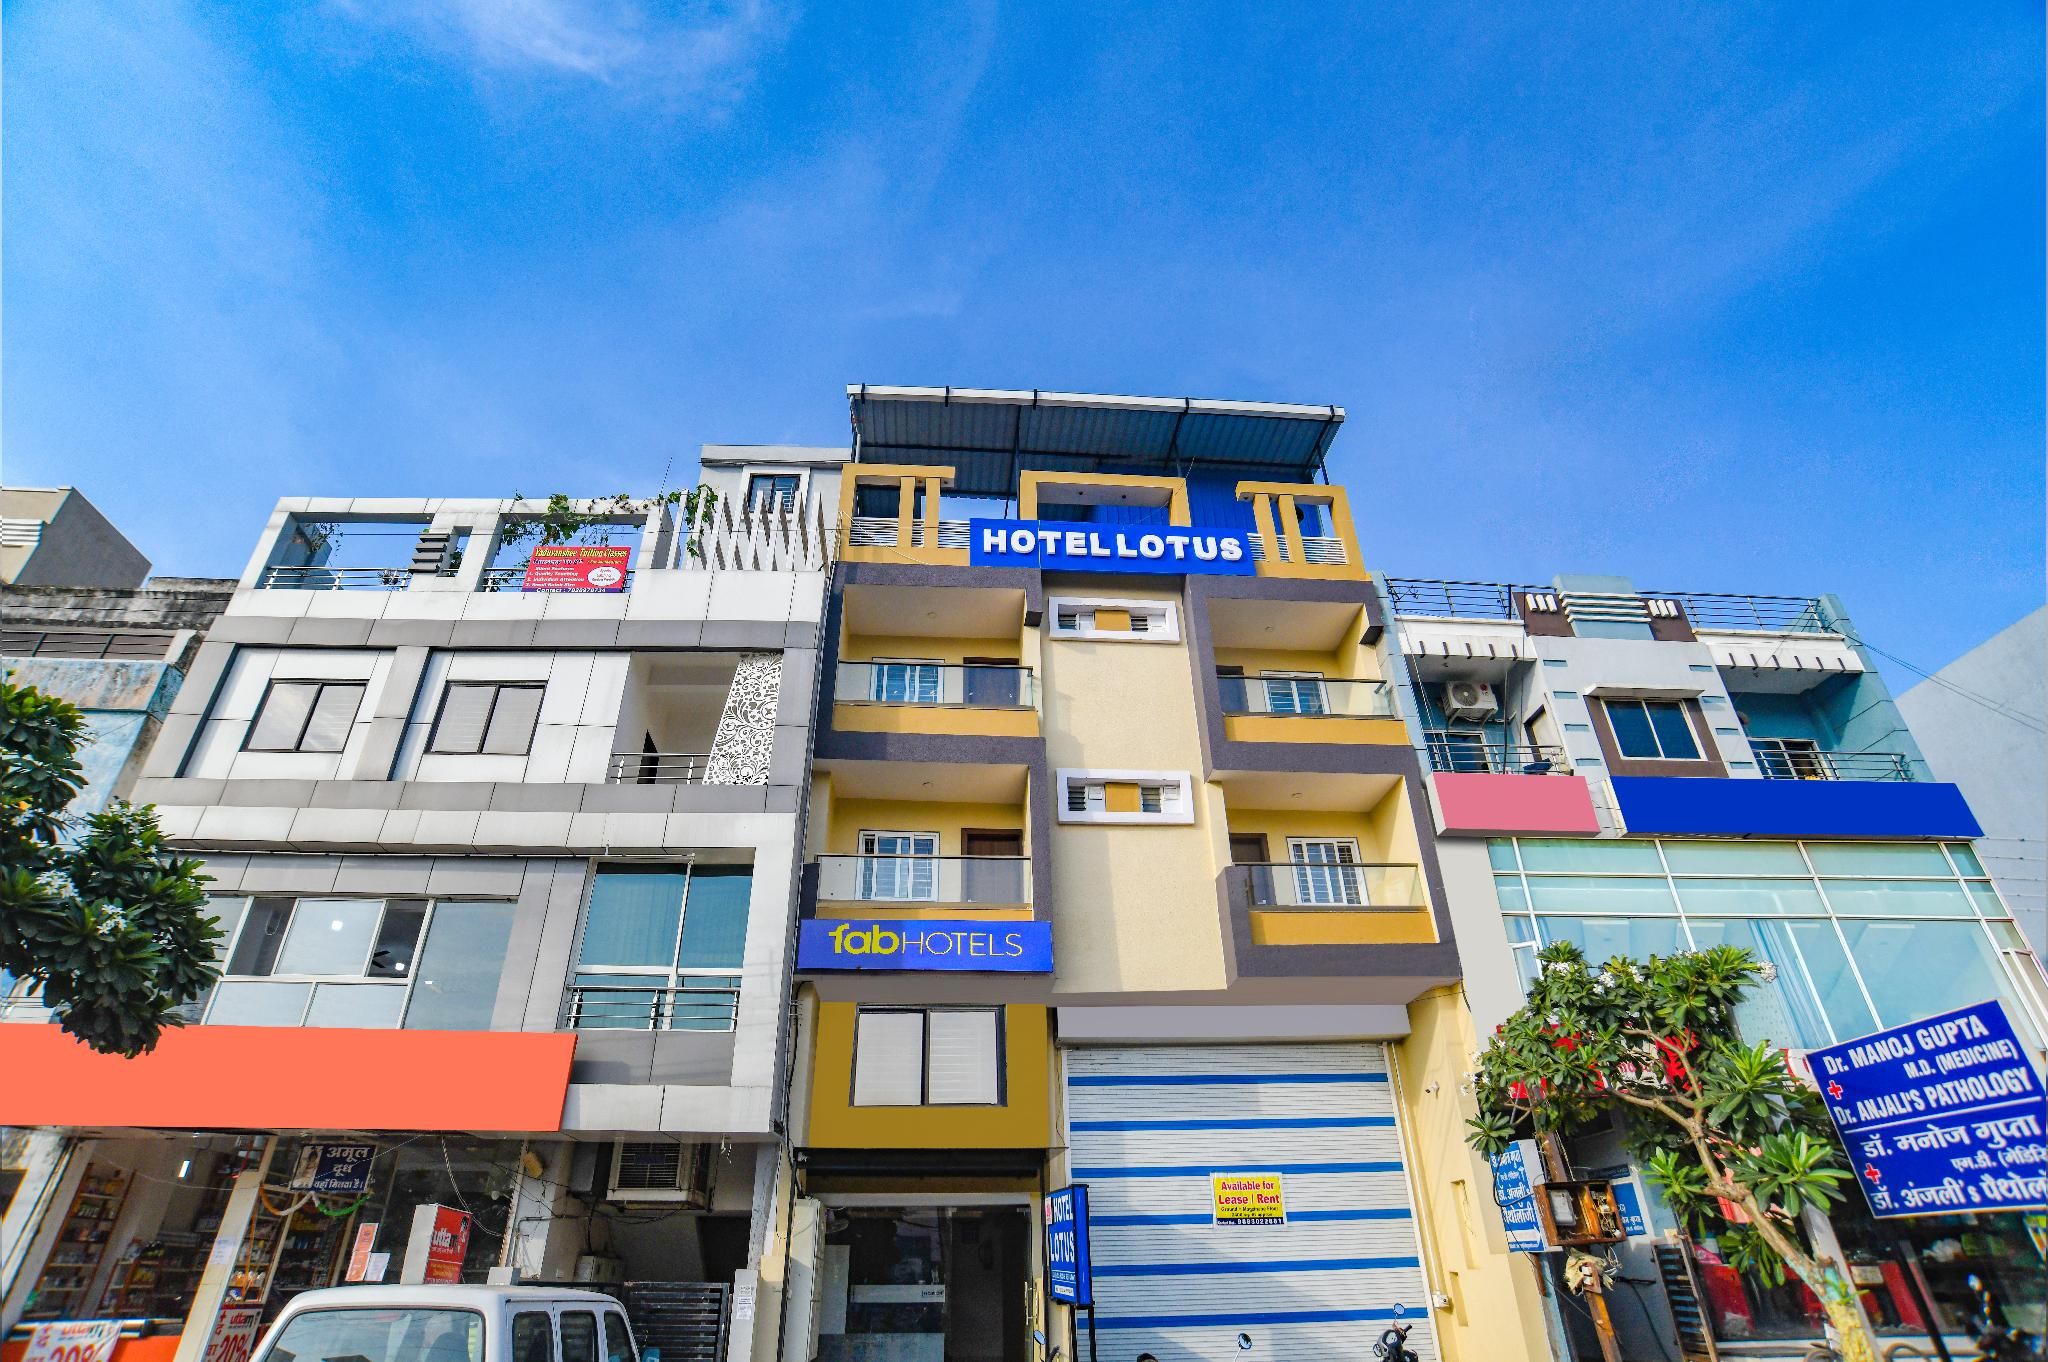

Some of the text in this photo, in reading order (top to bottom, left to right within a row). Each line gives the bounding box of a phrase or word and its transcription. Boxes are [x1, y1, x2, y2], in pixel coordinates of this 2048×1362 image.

[983, 528, 1243, 562] HOTEL LOTUS
[1823, 1014, 1990, 1076] Dr. MANOJ GUPTA
[1903, 1038, 2020, 1080] M.D. (MEDICINE)
[1833, 1066, 2034, 1126] Dr. ANJALI'S PATHOLOGY
[1860, 1114, 2043, 1159] डॉ. मनोज गुप्ता
[326, 1146, 370, 1163] अमूल
[1950, 1150, 1998, 1173] एम.डी.
[333, 1163, 354, 1177] दूध
[1218, 1194, 1248, 1205] Lease
[1256, 1193, 1280, 1204] Rent
[1221, 1180, 1274, 1191] Available for
[1871, 1185, 1900, 1210] डॉ.
[1053, 1194, 1074, 1223] HOTEL
[1049, 1232, 1075, 1263] LOTUS
